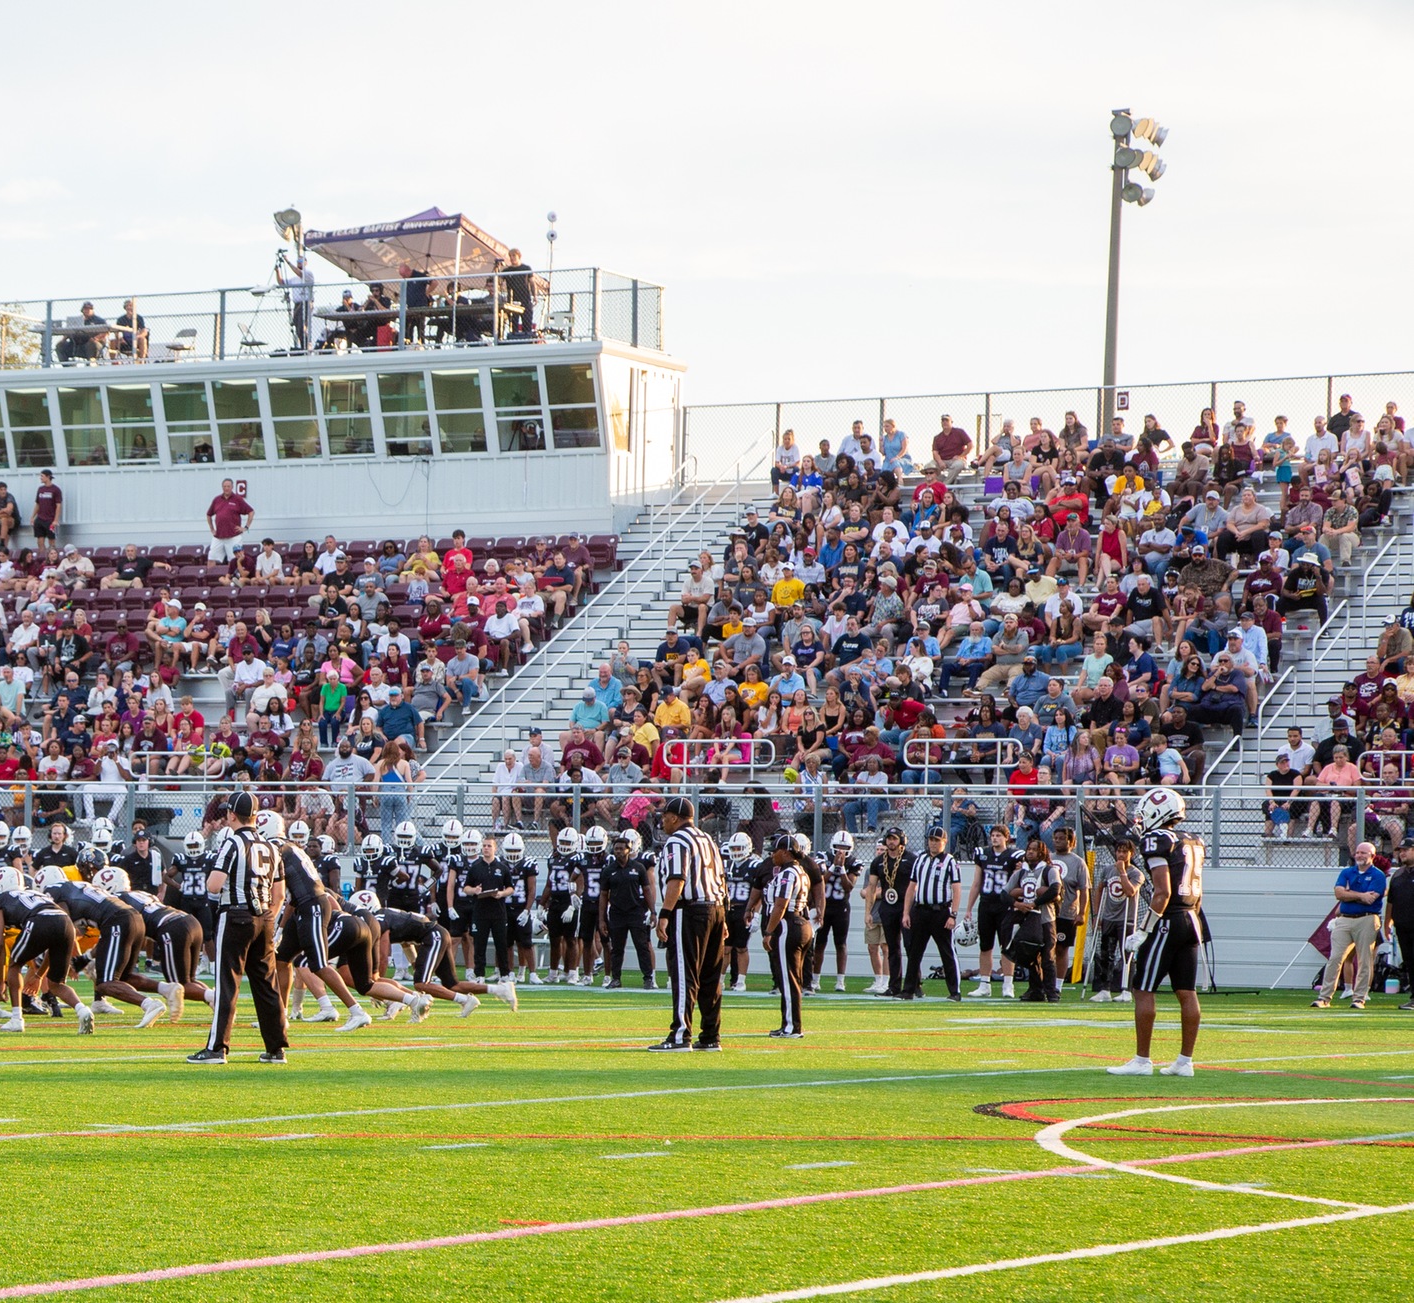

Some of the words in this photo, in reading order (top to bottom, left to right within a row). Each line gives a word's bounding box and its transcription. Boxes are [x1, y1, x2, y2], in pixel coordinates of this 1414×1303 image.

[1118, 394, 1129, 408] D
[237, 483, 246, 495] C
[1150, 790, 1168, 806] C
[1145, 837, 1158, 852] 15
[250, 842, 271, 877] C
[1178, 844, 1205, 897] 15
[183, 872, 207, 896] 23
[588, 872, 601, 898] 5
[984, 869, 1008, 894] 69
[888, 892, 895, 901] C
[1023, 883, 1035, 898] C
[1112, 882, 1124, 897] C
